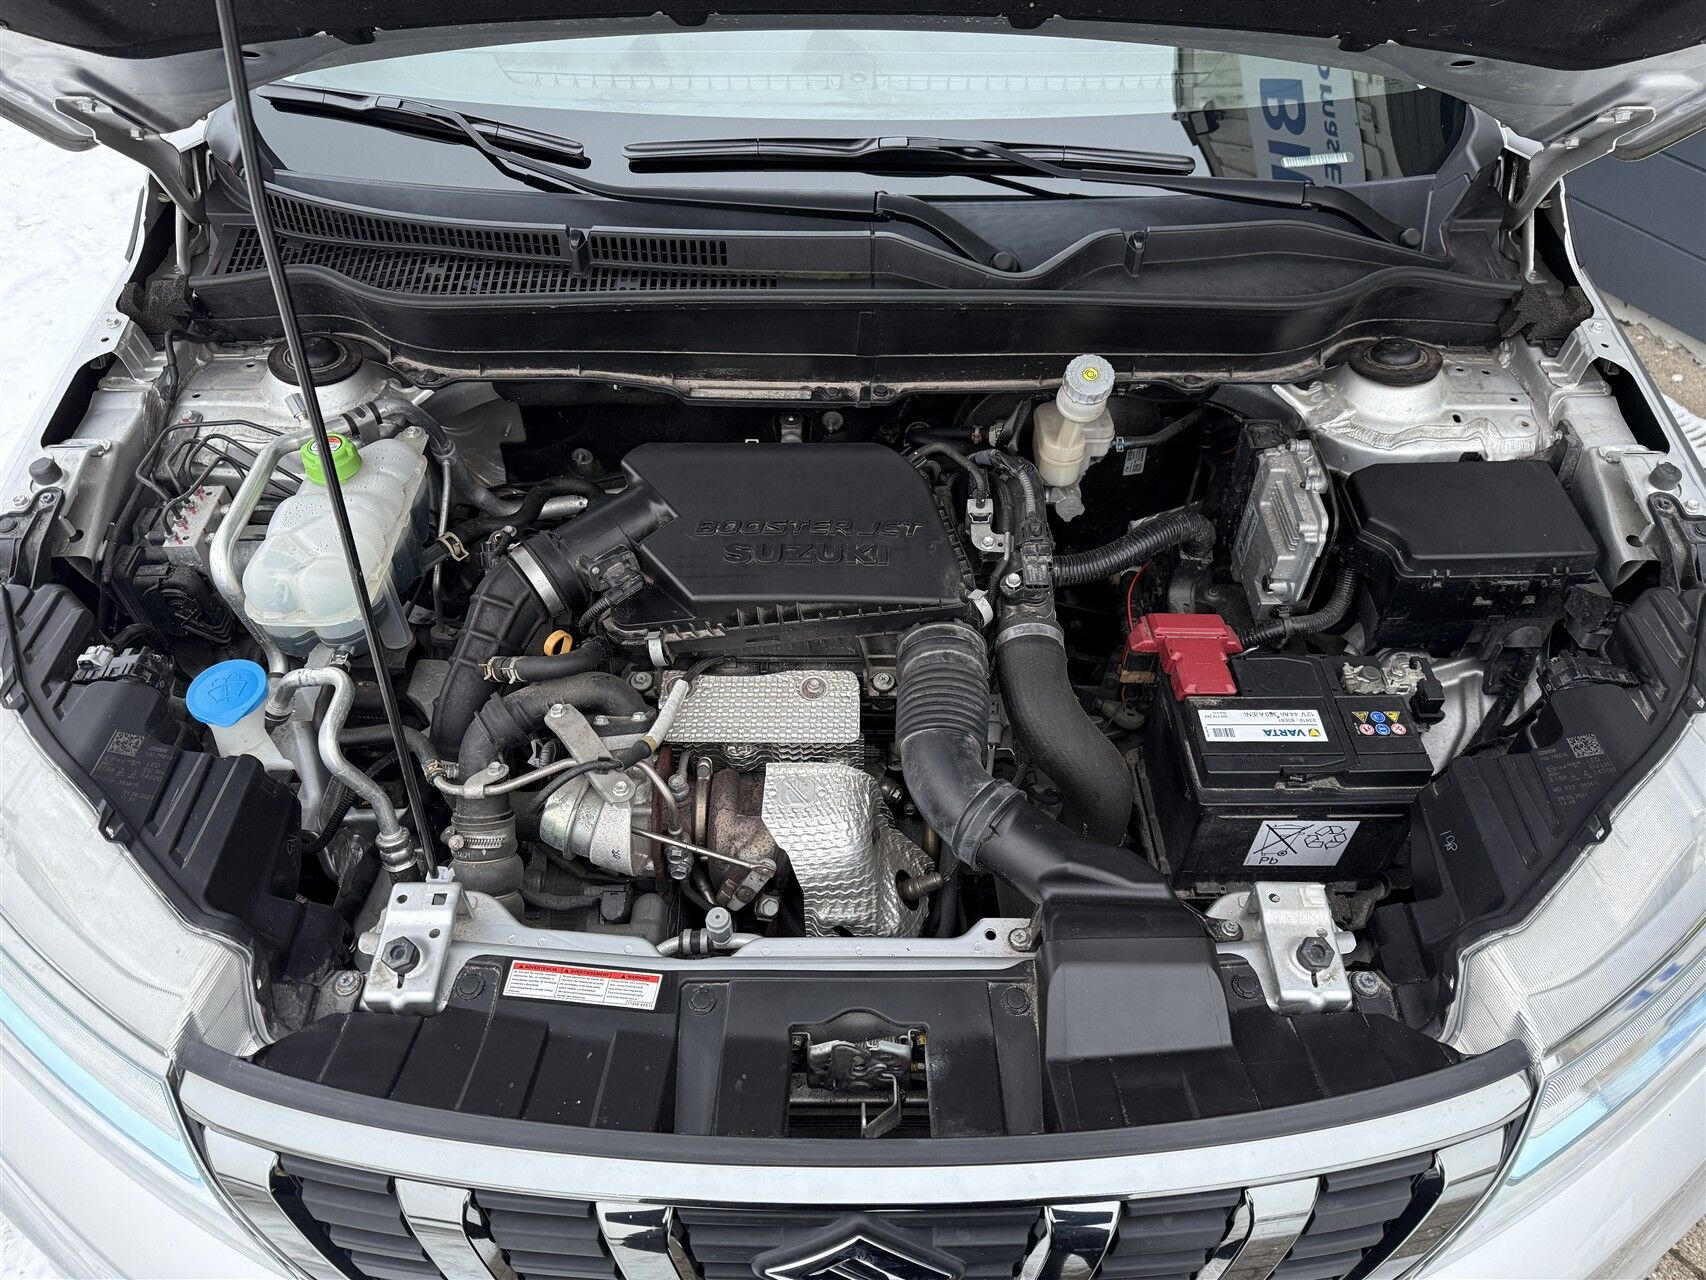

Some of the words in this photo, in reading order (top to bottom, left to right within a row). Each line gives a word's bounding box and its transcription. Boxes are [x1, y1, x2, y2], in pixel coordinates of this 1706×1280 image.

[720, 542, 890, 566] SUZUKI
[1262, 728, 1306, 737] VARTA
[1258, 856, 1279, 865] Pb
